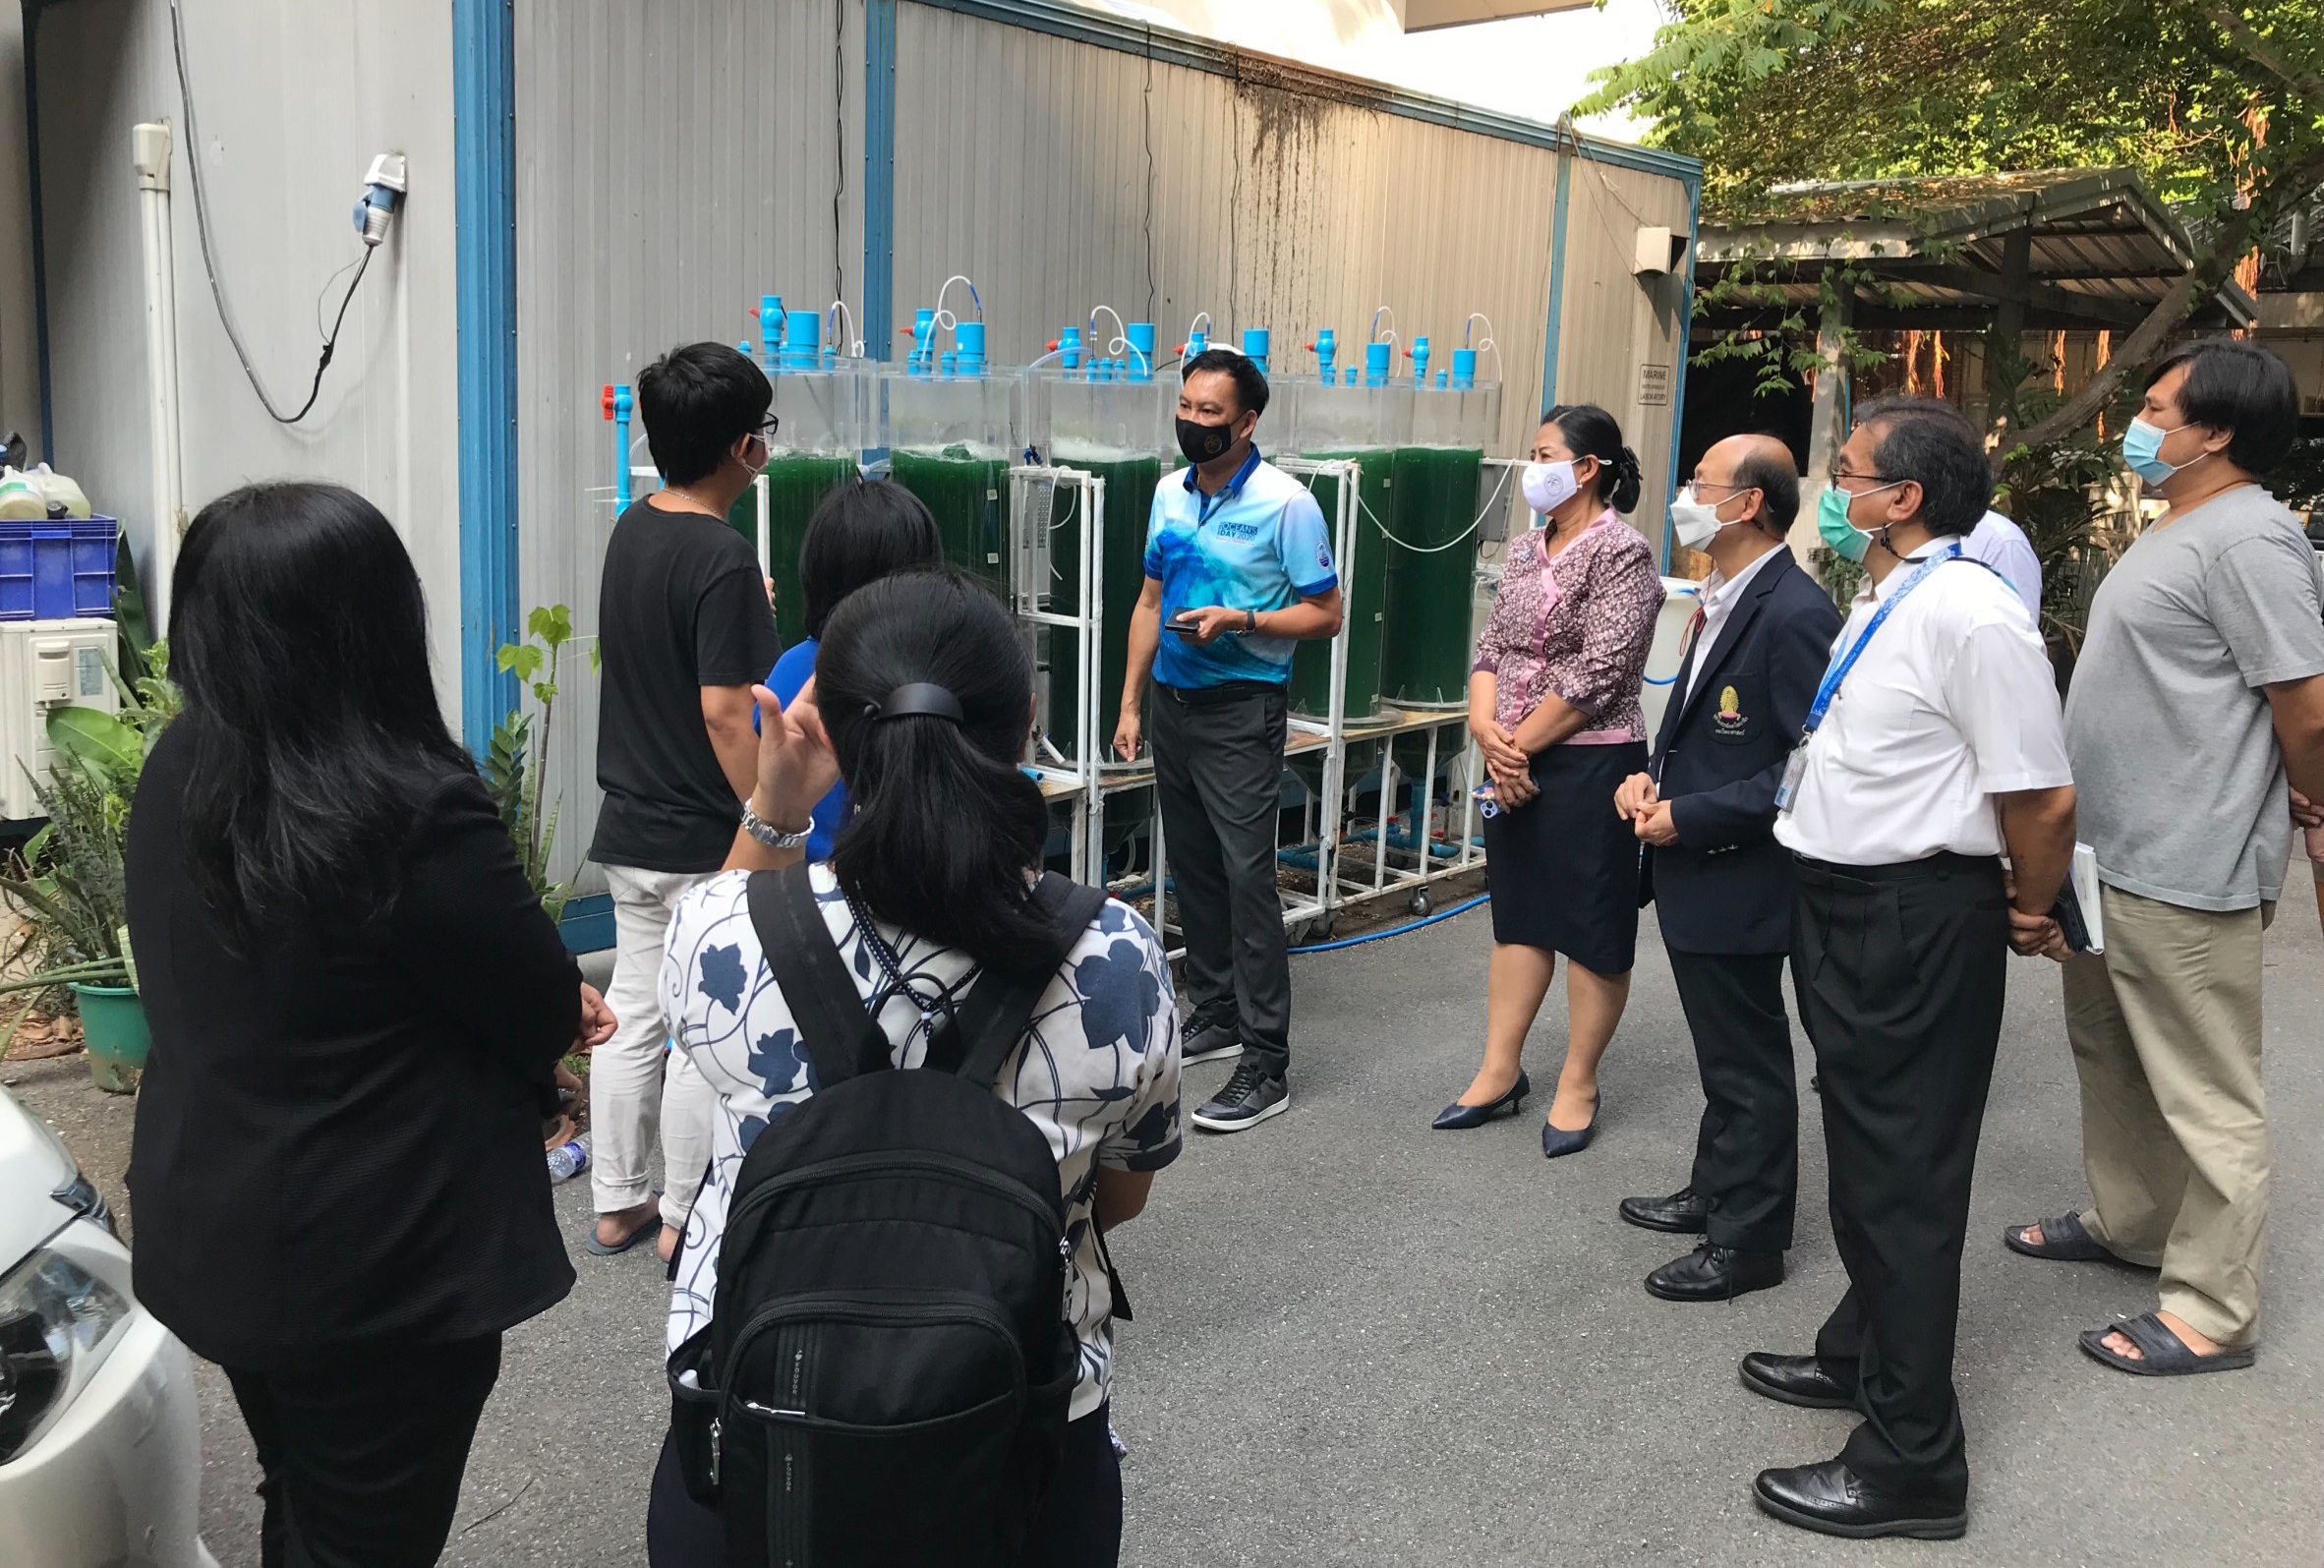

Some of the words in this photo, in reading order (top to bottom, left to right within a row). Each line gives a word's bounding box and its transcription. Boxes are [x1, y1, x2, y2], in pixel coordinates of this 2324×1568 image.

[1643, 370, 1666, 380] MARINE
[1222, 522, 1257, 535] OCEANS
[1237, 532, 1255, 542] 2020
